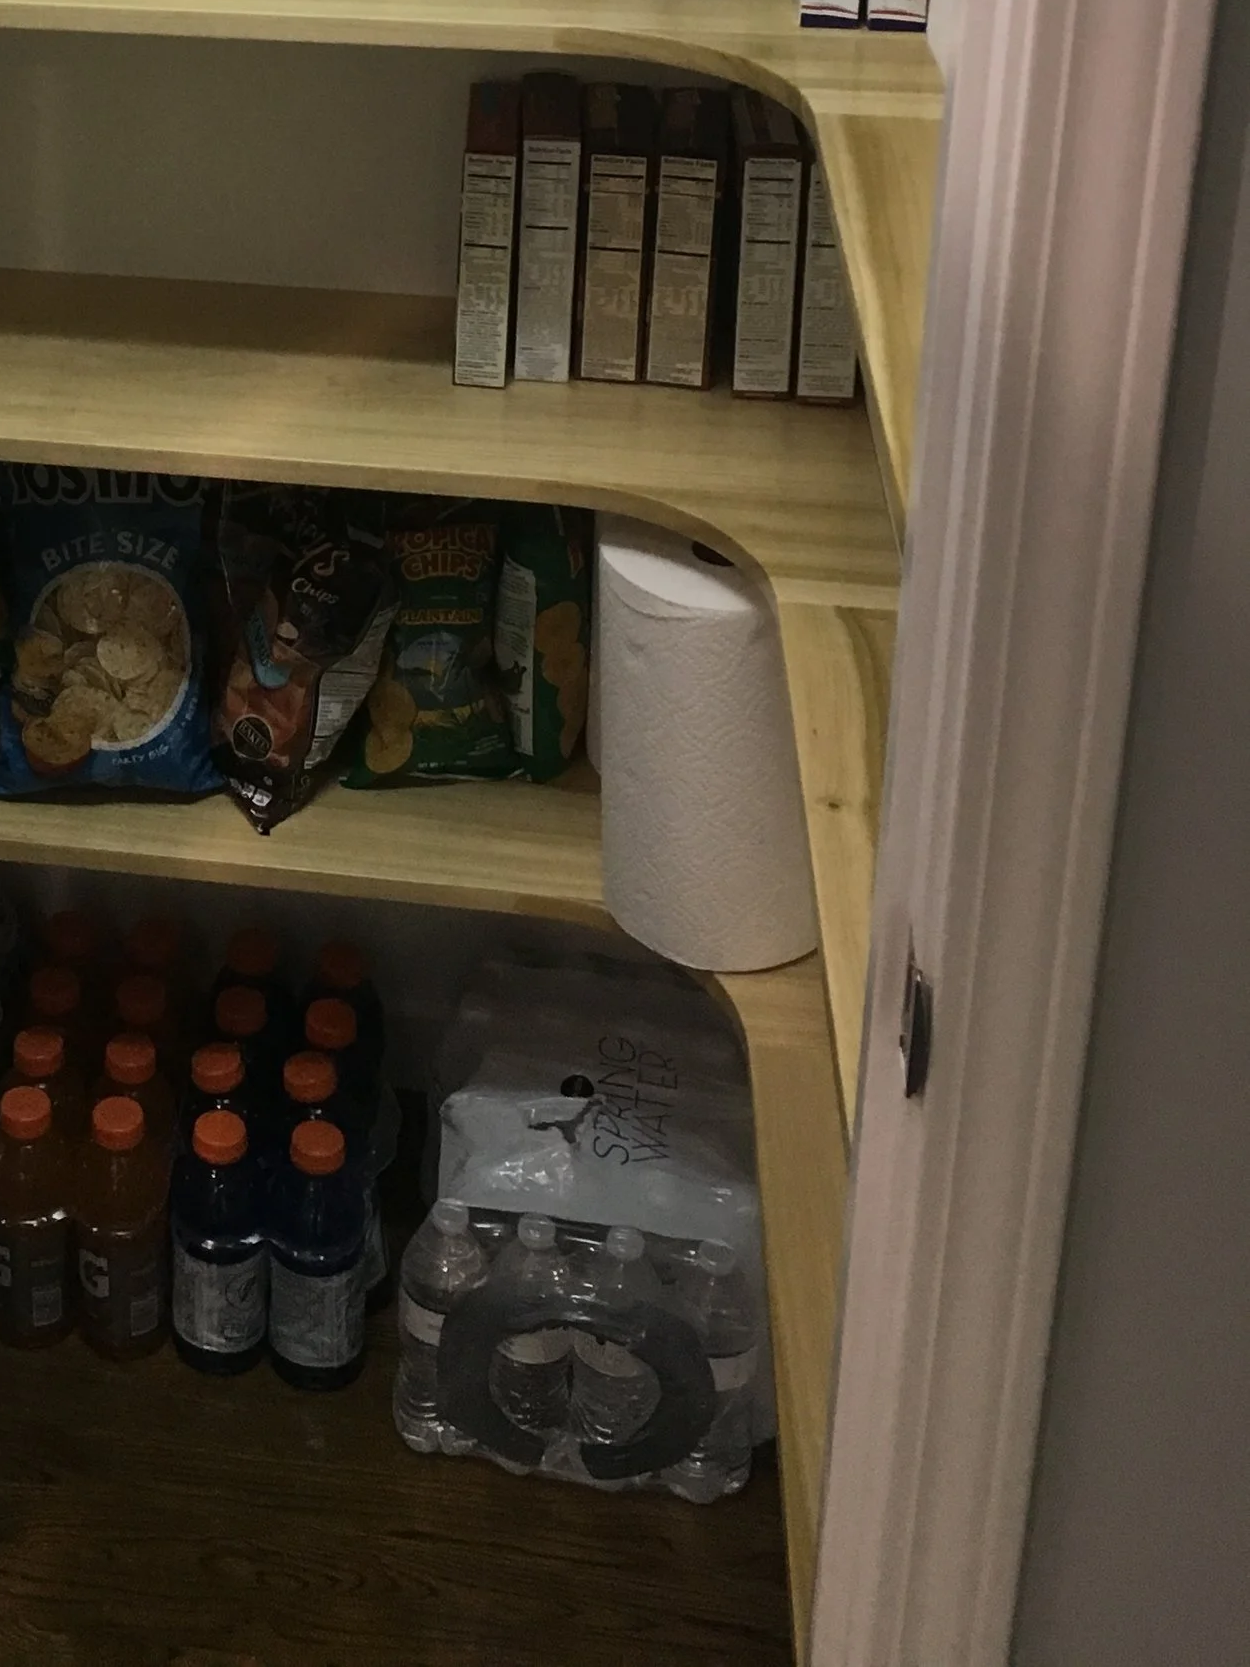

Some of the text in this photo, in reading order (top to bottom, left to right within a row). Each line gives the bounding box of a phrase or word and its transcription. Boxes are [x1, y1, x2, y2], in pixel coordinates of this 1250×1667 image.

[41, 530, 180, 572] BITE SIZE
[401, 553, 481, 581] CHIPS
[291, 577, 340, 604] Chips
[631, 1050, 678, 1162] WATER
